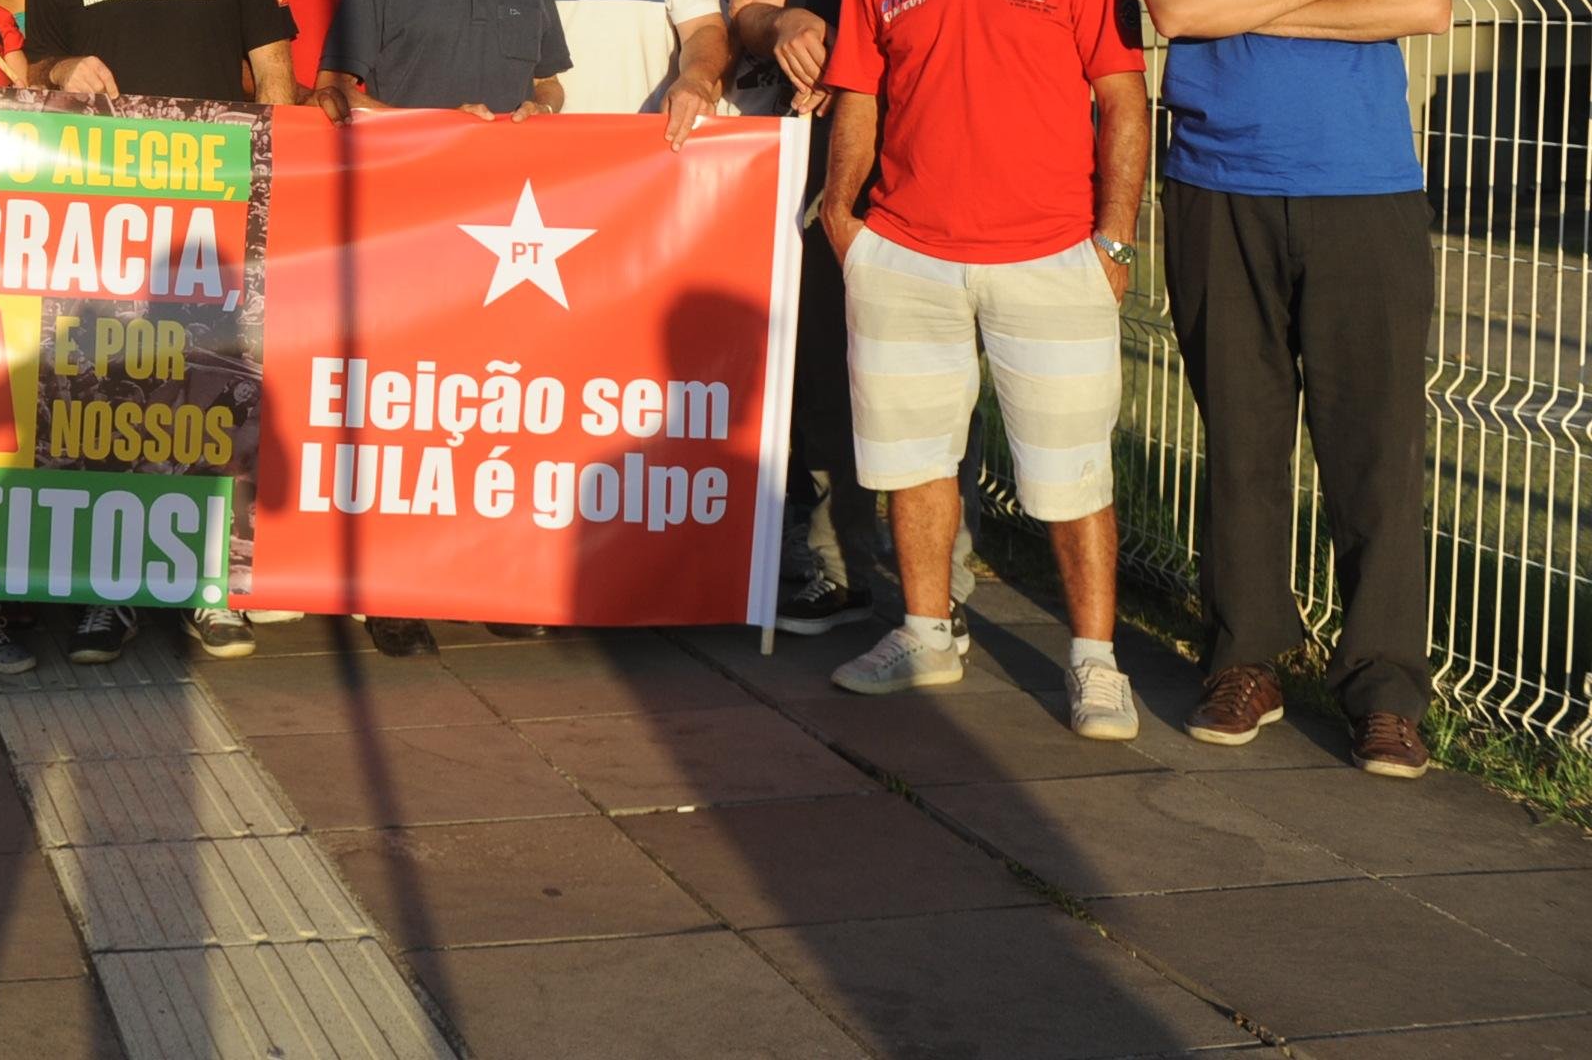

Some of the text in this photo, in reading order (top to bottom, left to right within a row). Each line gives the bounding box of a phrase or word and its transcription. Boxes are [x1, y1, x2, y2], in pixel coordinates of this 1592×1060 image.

[50, 124, 237, 199] ALEGRE,
[511, 241, 543, 264] PT
[53, 315, 80, 377] E
[98, 318, 186, 382] POR
[50, 401, 234, 466] NOSSOS
[308, 356, 730, 446] Eleição sem
[298, 442, 728, 532] LULA é golpe
